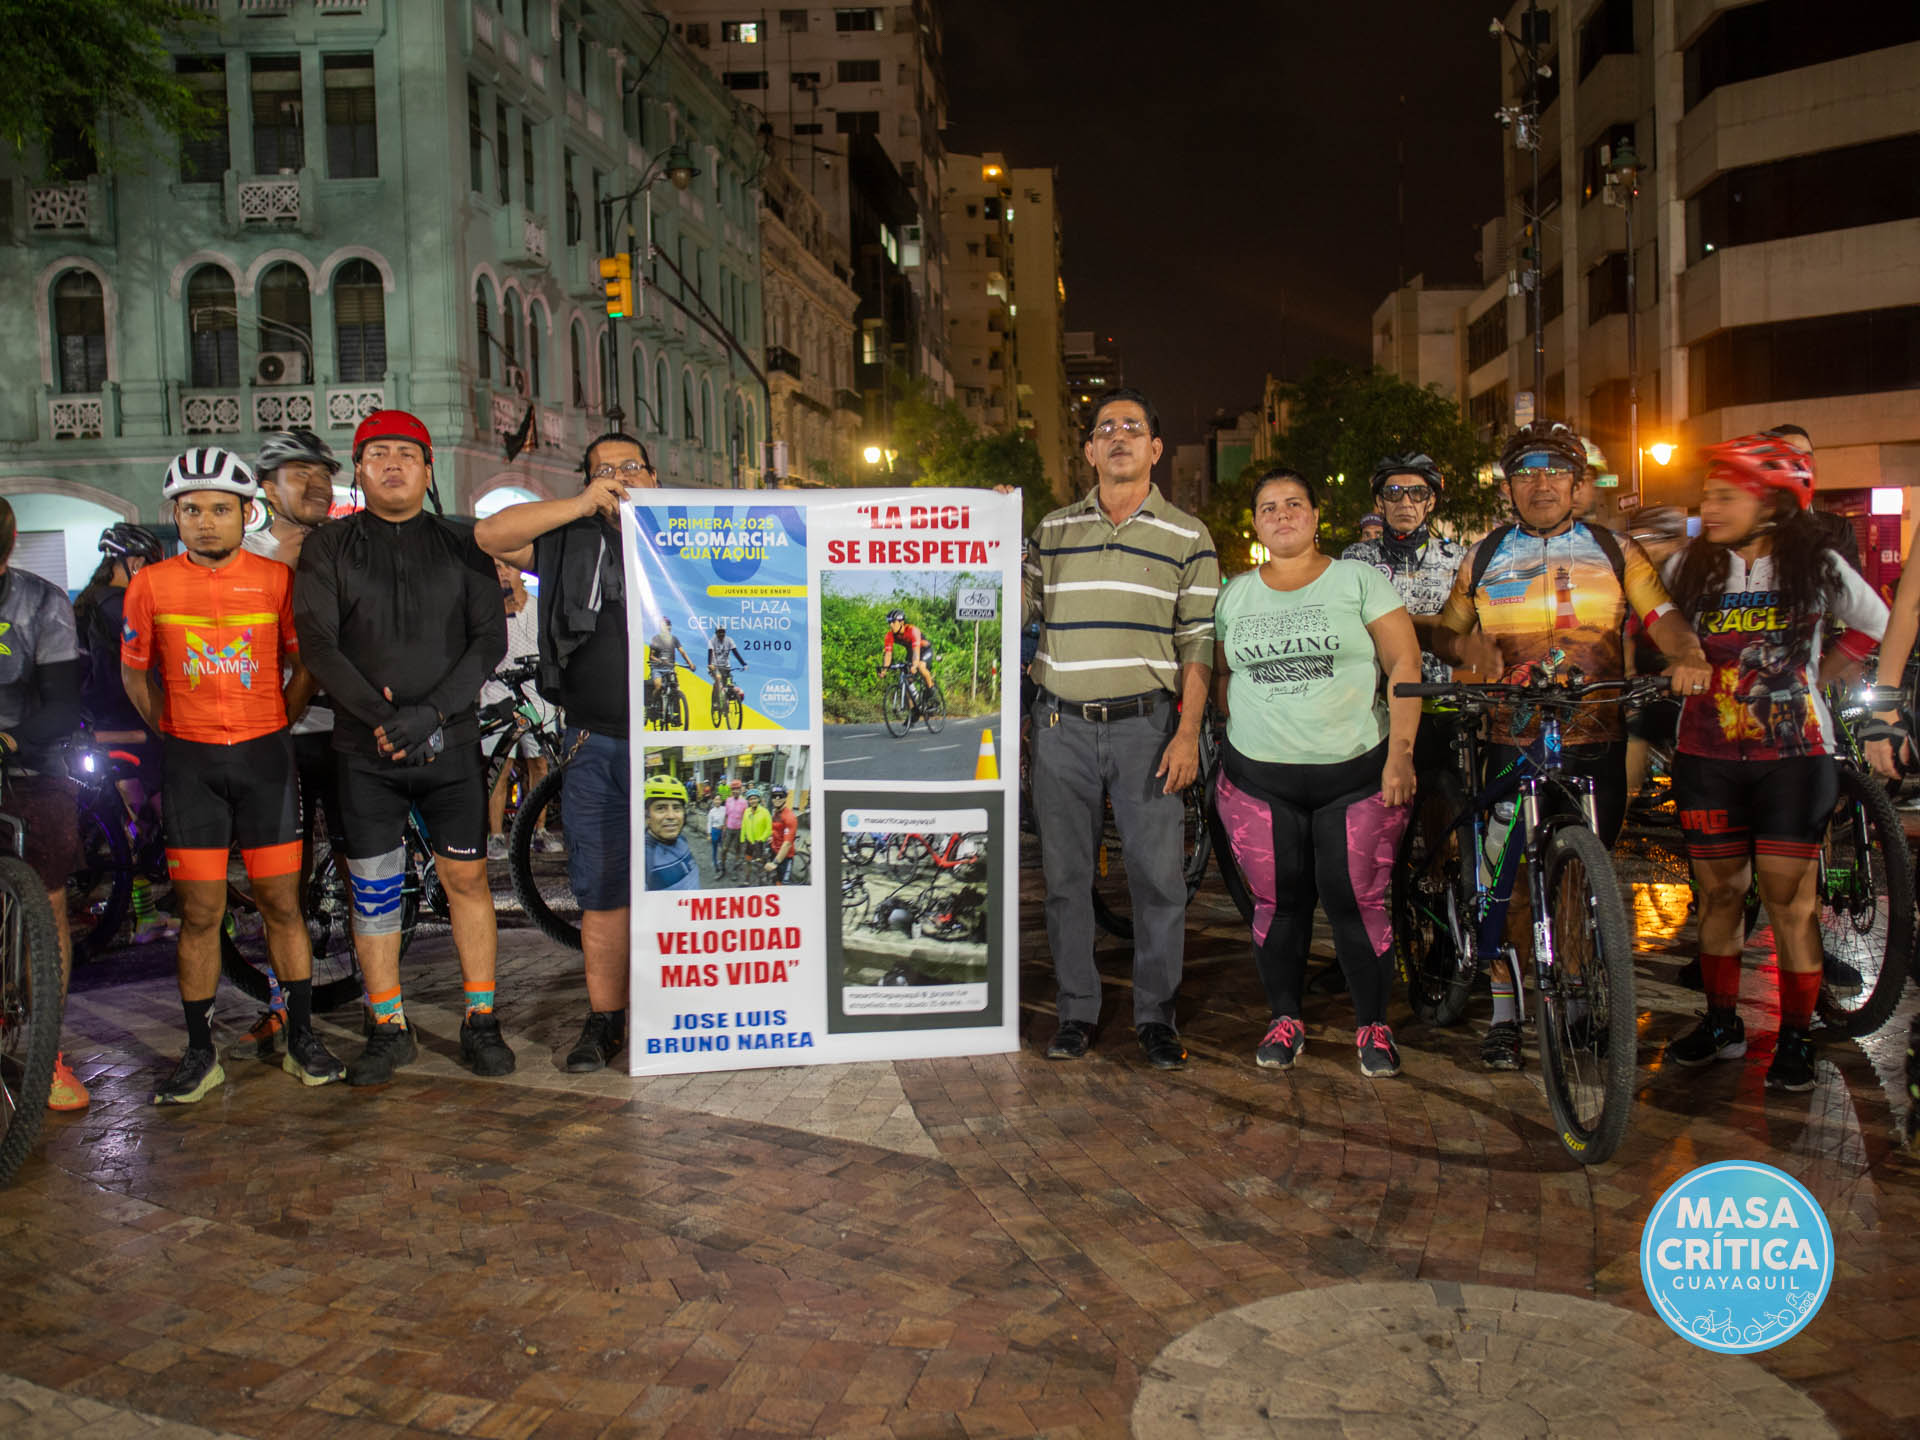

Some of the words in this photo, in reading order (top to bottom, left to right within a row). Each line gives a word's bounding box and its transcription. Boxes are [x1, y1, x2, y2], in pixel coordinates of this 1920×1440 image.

[668, 518, 774, 530] PRIMERA-2025
[910, 505, 970, 529] BICI
[655, 531, 789, 548] CICLOMARCHA
[679, 547, 770, 562] GUAYAQUIL
[827, 540, 861, 564] SE
[741, 600, 791, 614] PLAZA
[687, 616, 792, 631] CENTENARIO
[743, 640, 792, 651] 20H00
[1234, 634, 1341, 664] AMAZING
[656, 926, 802, 955] VELOCIDAD
[660, 964, 719, 988] MAS
[672, 1012, 729, 1030] JOSE
[735, 1009, 788, 1027] LUIS
[646, 1035, 730, 1054] BRUNO
[738, 1031, 815, 1050] NAREA
